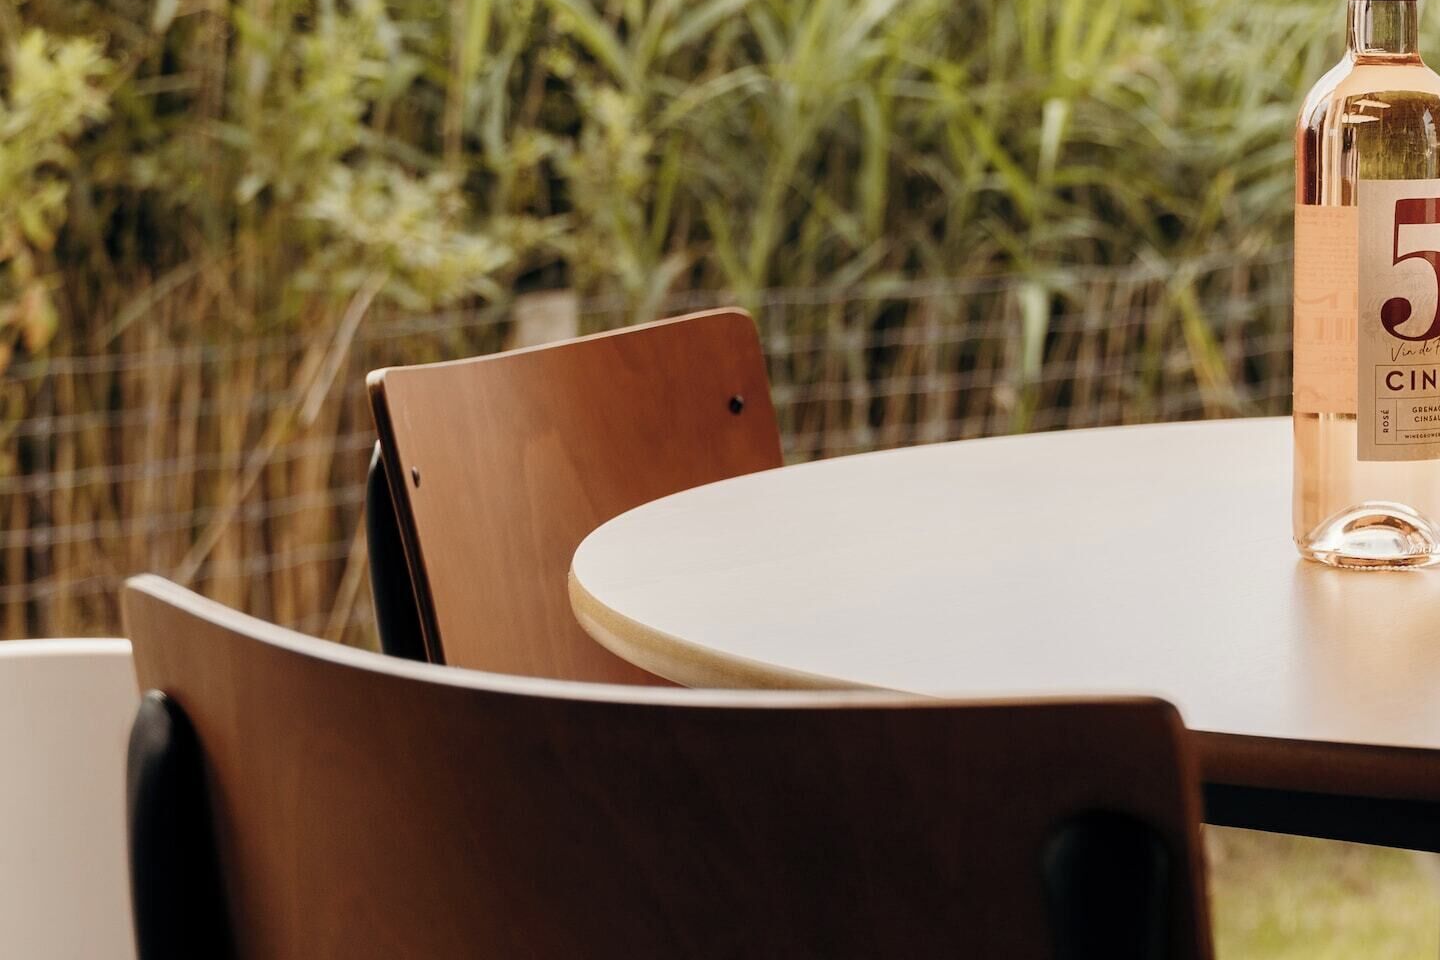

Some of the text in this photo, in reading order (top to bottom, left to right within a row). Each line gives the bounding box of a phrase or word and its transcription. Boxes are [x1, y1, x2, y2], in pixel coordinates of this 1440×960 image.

[1391, 342, 1416, 362] Vin
[1419, 340, 1431, 356] de
[1380, 409, 1390, 433] ROSÉ
